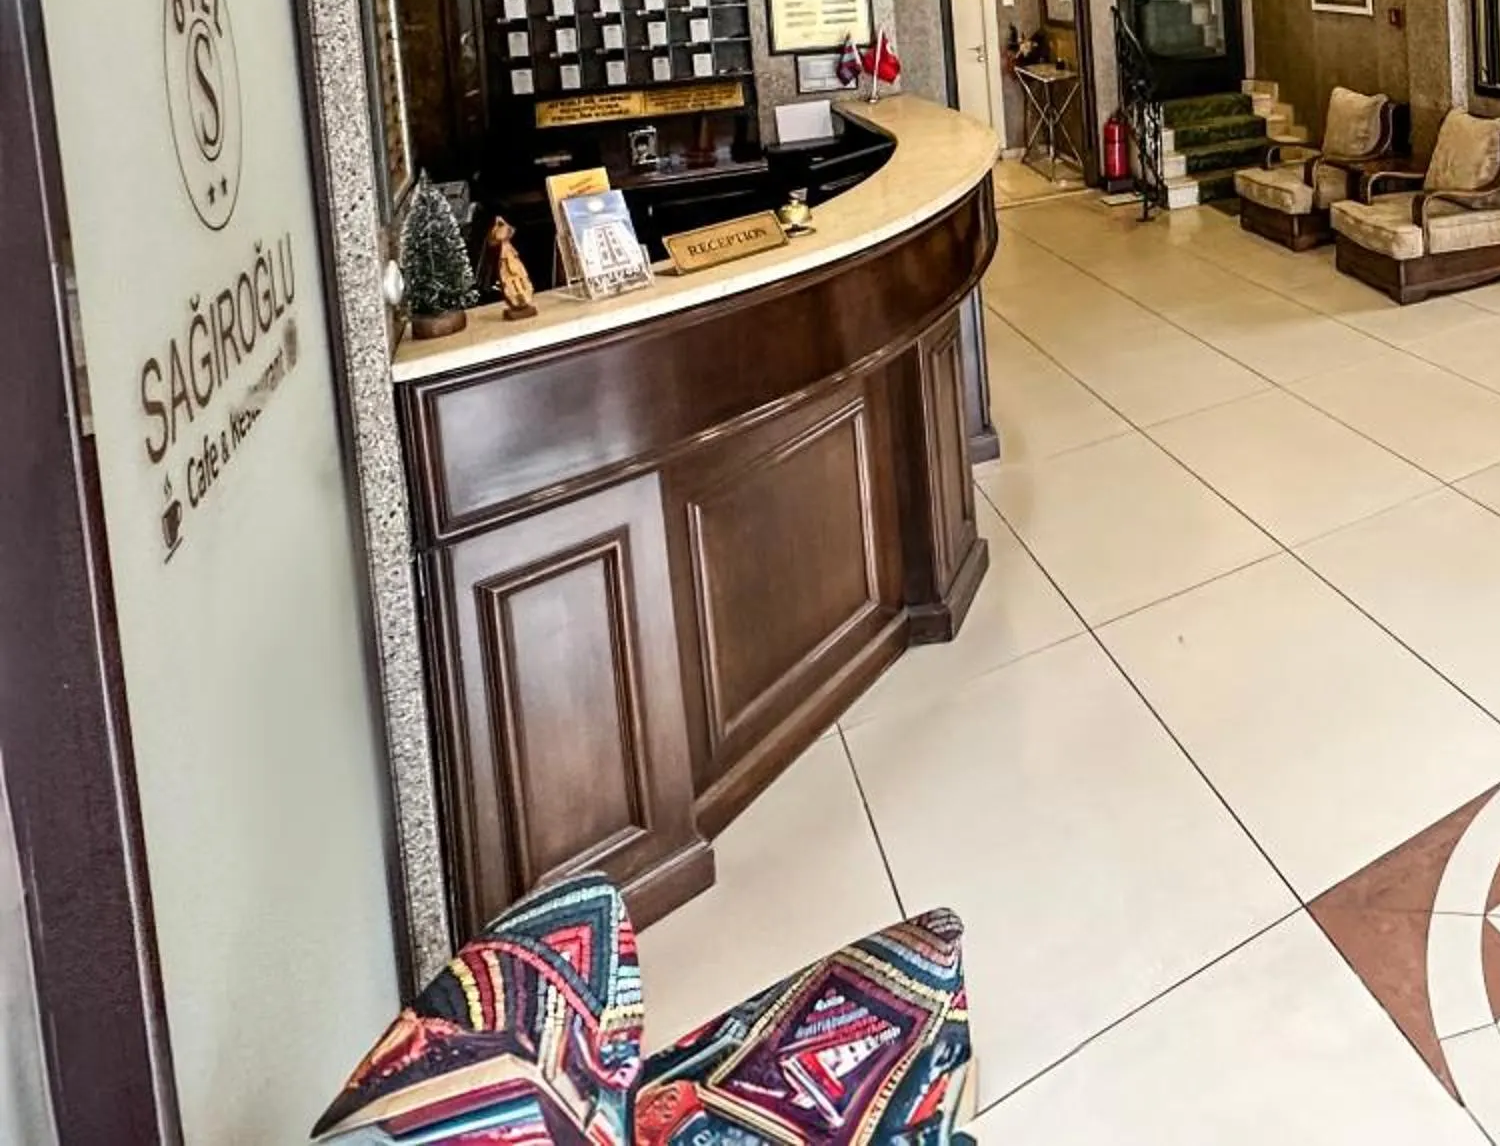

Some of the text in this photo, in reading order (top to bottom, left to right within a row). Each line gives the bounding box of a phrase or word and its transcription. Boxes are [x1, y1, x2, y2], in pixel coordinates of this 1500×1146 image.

[686, 228, 767, 257] RECEPTION
[141, 232, 295, 464] SAĞIROĞLU
[187, 433, 219, 509] Cafe
